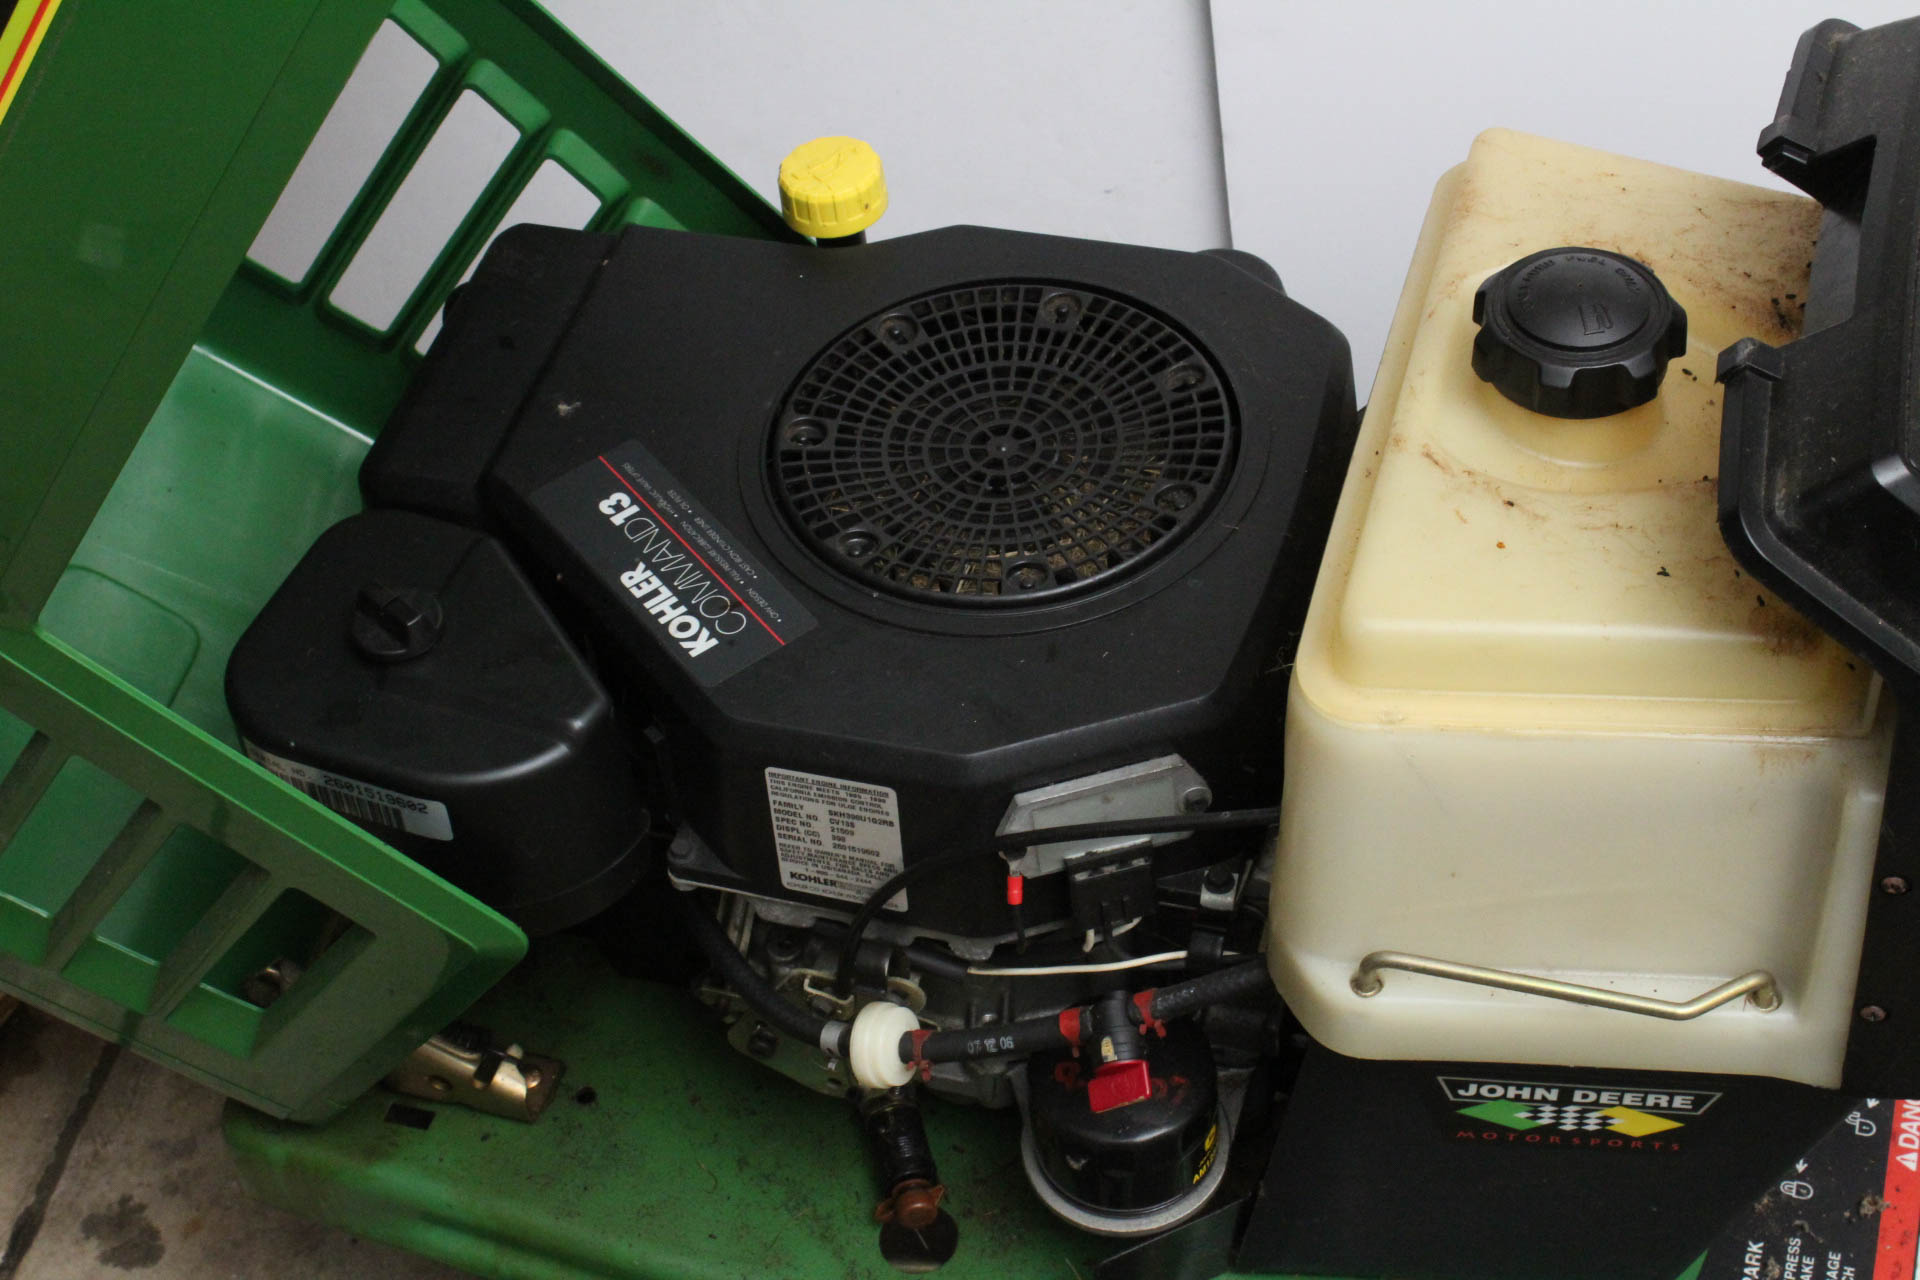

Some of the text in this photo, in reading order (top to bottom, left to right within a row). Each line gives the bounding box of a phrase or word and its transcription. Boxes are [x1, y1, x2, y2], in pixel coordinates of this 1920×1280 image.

[620, 561, 719, 658] KOHLER
[322, 775, 429, 814] 2601519602
[772, 800, 803, 810] FAMILY
[773, 808, 802, 818] MODEL
[775, 816, 796, 825] SPEC
[777, 832, 807, 843] SERIAL
[790, 871, 836, 887] KOHLER
[1000, 1036, 1015, 1050] 06
[1457, 1083, 1694, 1109] JOHN DEERE
[1456, 1130, 1681, 1151] MOTORSPORTS
